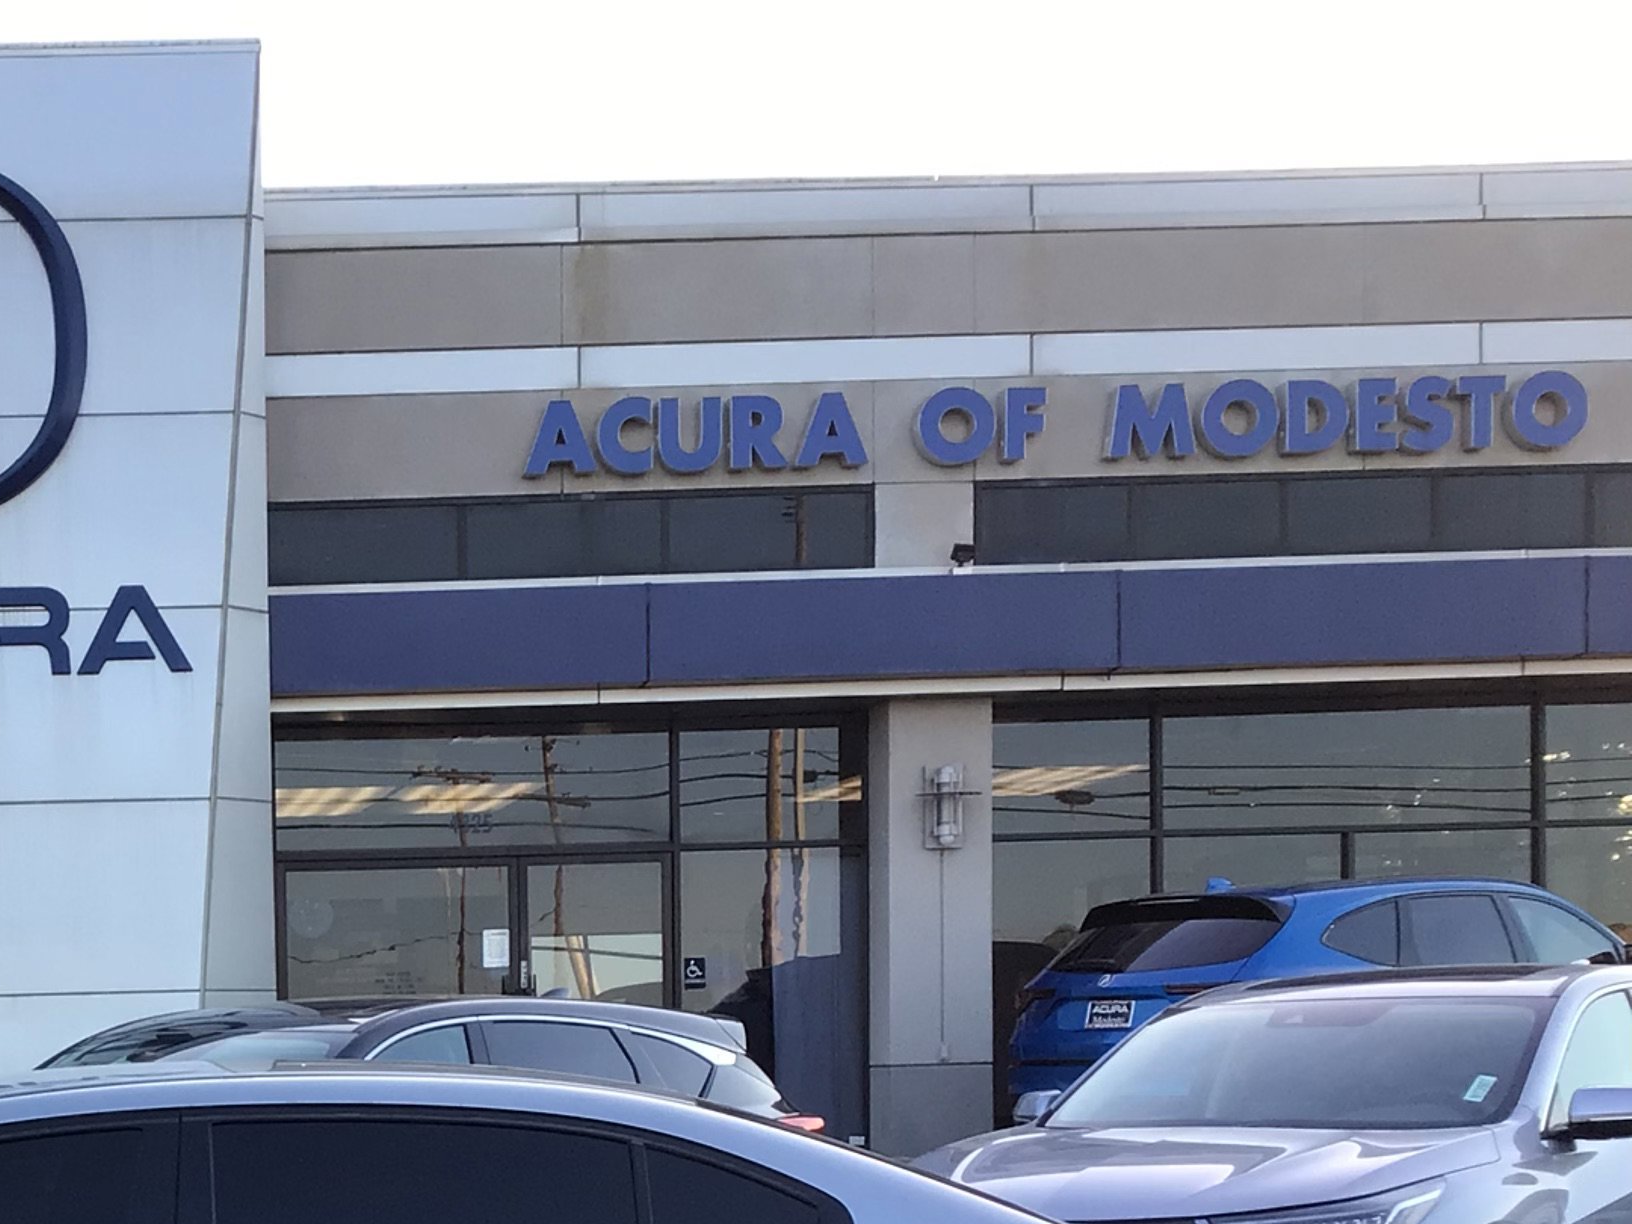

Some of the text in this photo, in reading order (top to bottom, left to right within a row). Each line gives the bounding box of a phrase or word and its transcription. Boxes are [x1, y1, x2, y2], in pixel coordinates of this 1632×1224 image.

[523, 369, 1589, 478] ACURA OF MODESTO
[1092, 1004, 1129, 1013] ACURA
